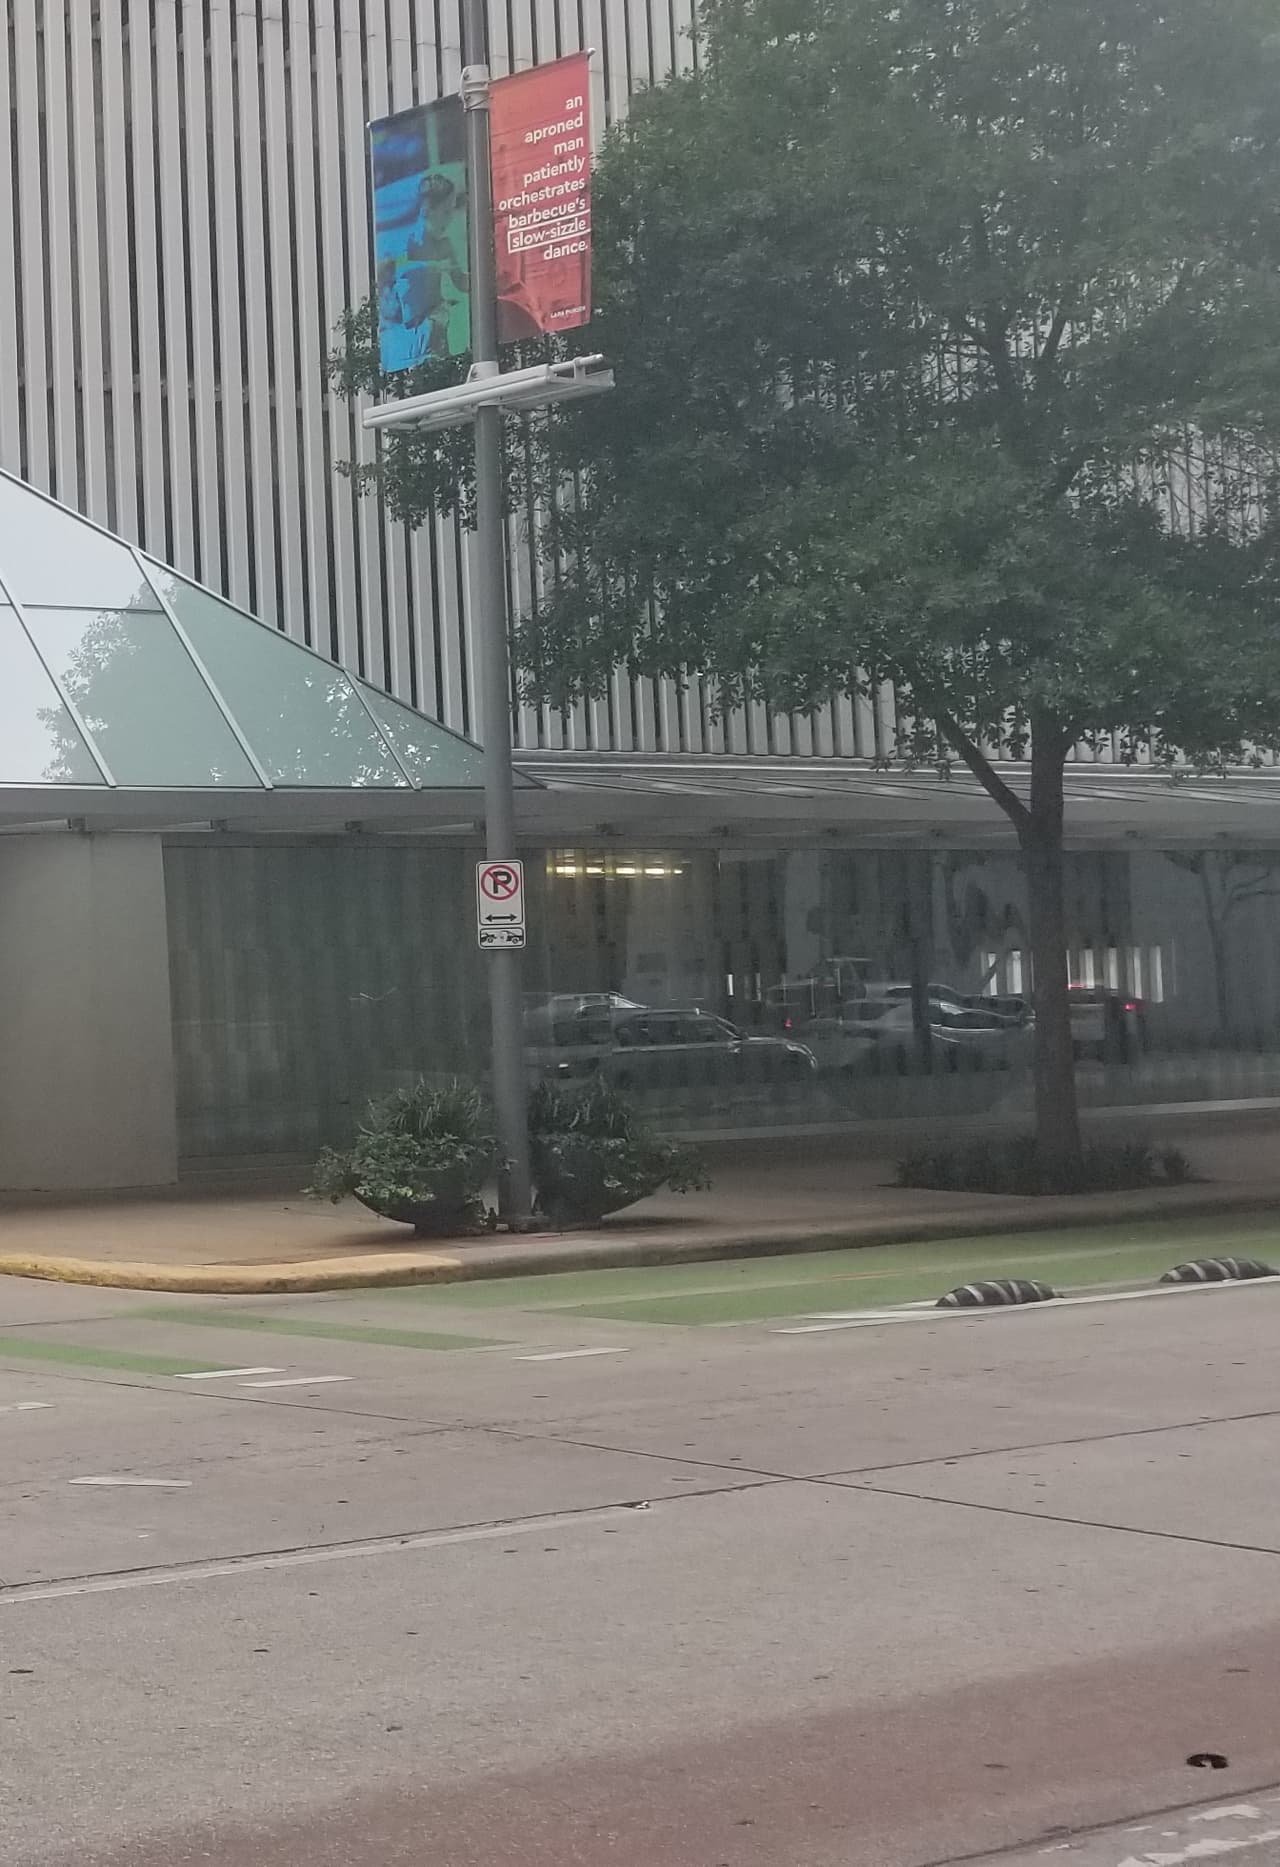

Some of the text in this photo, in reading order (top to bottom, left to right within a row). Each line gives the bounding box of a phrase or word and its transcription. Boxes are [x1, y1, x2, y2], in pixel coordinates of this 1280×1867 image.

[565, 95, 583, 110] an
[524, 112, 584, 144] aproned
[553, 137, 584, 156] man
[523, 155, 585, 188] patiently
[499, 177, 585, 211] orchestrates
[508, 197, 586, 229] barbecue's
[512, 217, 586, 248] slow-sizzle
[543, 240, 588, 260] dance.
